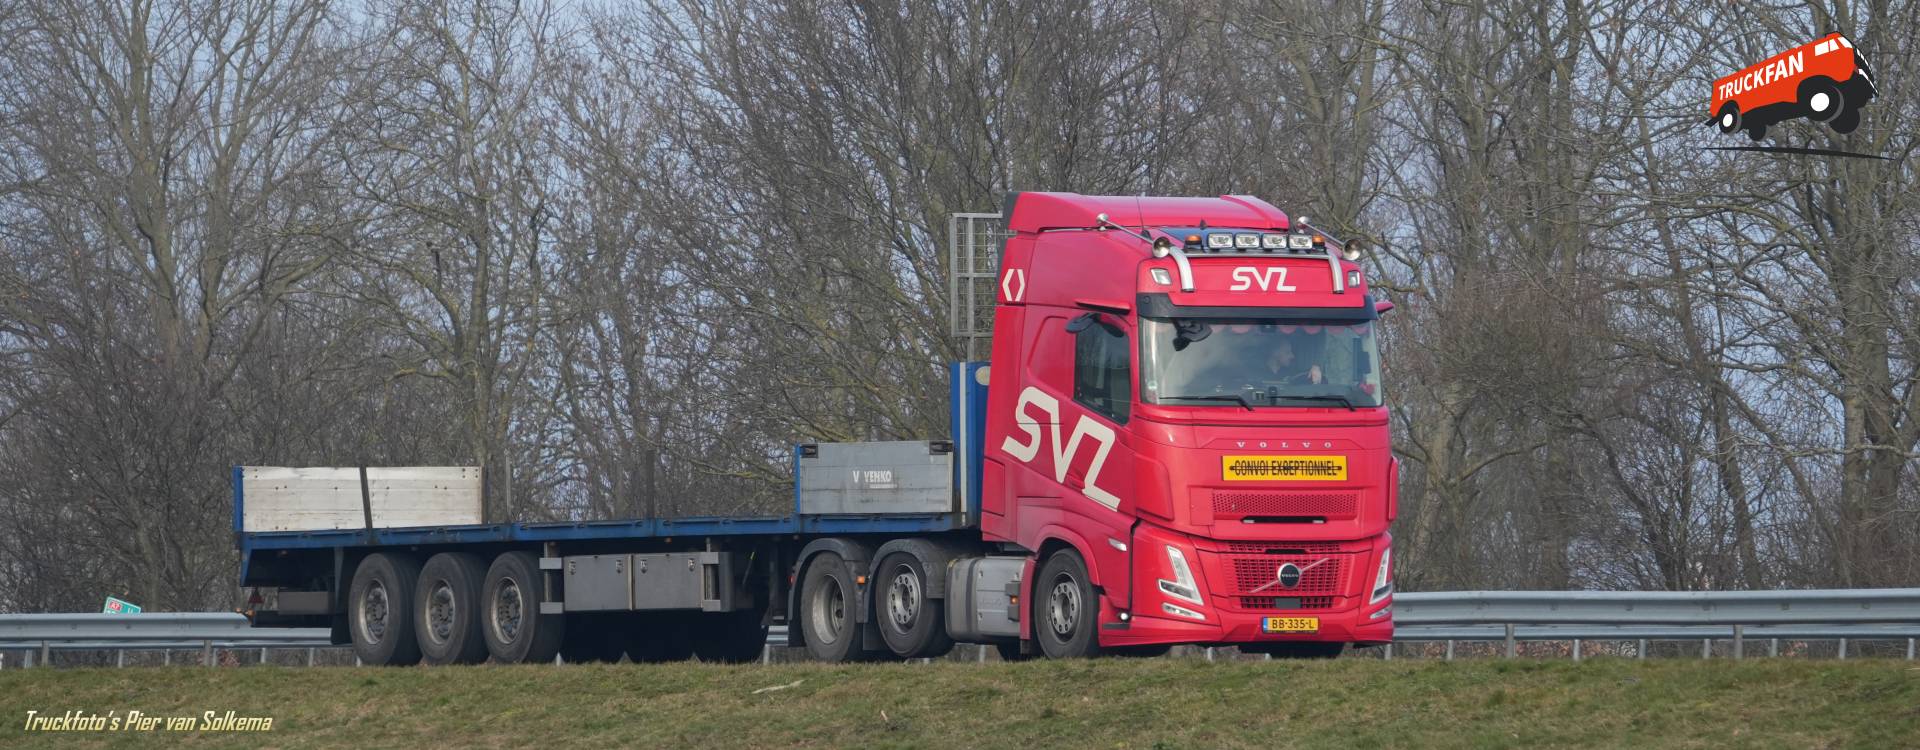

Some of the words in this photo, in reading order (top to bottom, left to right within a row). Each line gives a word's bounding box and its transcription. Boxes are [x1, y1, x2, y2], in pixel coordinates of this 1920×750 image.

[1230, 266, 1297, 291] SVZ
[1001, 386, 1121, 512] SVZ
[1236, 441, 1332, 449] VOLVO
[1234, 460, 1269, 476] CONVOI
[1271, 460, 1337, 476] EXCEPTIONNEL
[1272, 618, 1315, 629] BB-335-L
